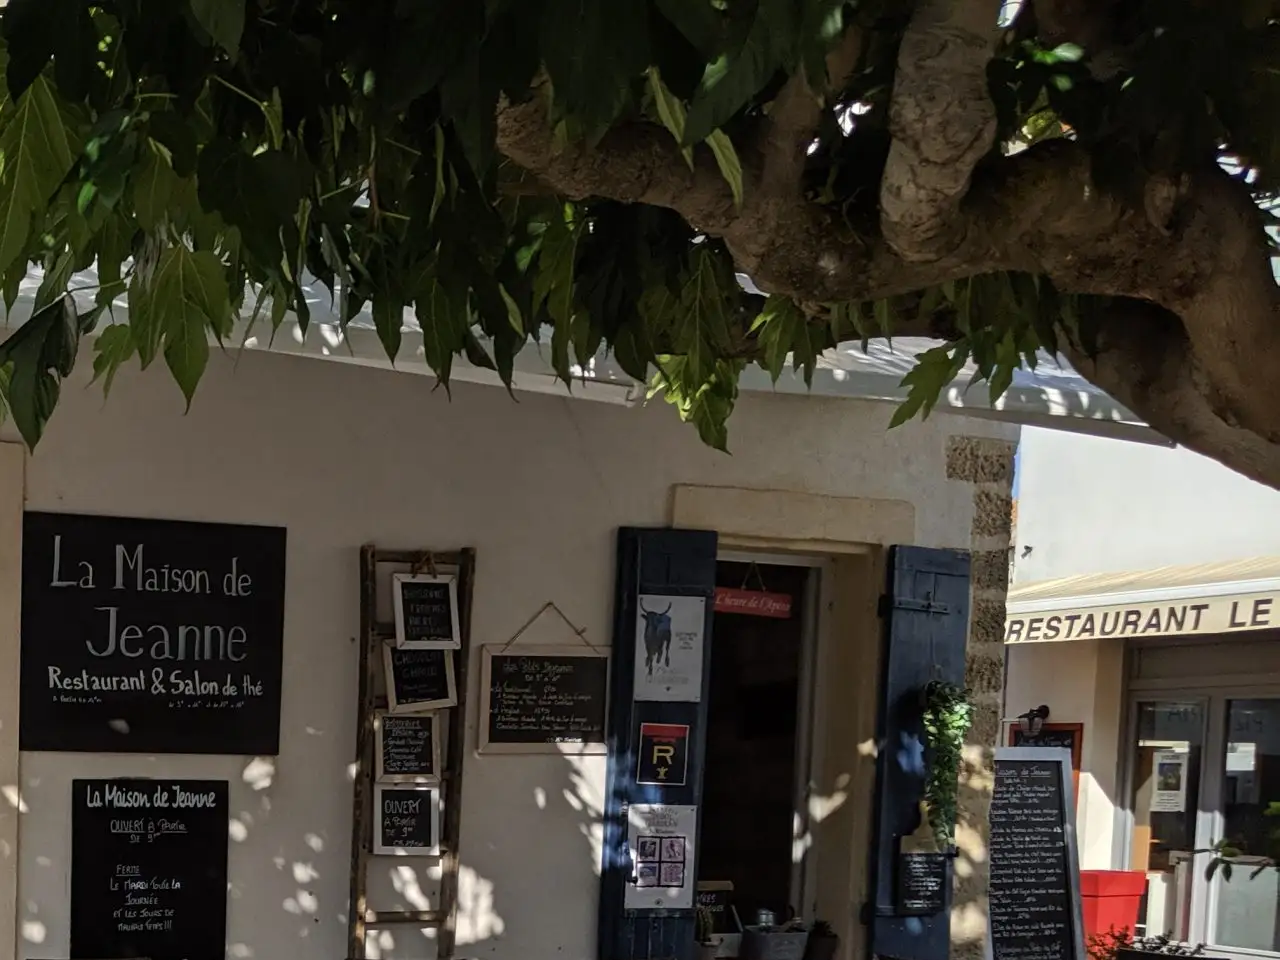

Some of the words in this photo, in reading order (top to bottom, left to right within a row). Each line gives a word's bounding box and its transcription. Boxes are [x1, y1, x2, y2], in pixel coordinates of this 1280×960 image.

[50, 535, 96, 589] La
[112, 543, 211, 594] Maison
[223, 557, 252, 596] de
[1005, 604, 1210, 642] RESTAURANT
[1228, 598, 1274, 628] LE
[86, 605, 248, 662] Jeanne
[48, 665, 145, 691] Restaurant
[151, 667, 167, 695] &
[170, 669, 219, 696] Salon
[222, 673, 238, 696] de
[243, 674, 264, 696] thé
[652, 745, 675, 765] R
[87, 785, 102, 808] La
[105, 784, 150, 809] Maison
[153, 785, 169, 808] de
[171, 785, 217, 809] Jeanne
[385, 798, 421, 814] OUVERT
[110, 817, 145, 833] OUVERT
[171, 878, 181, 890] LA
